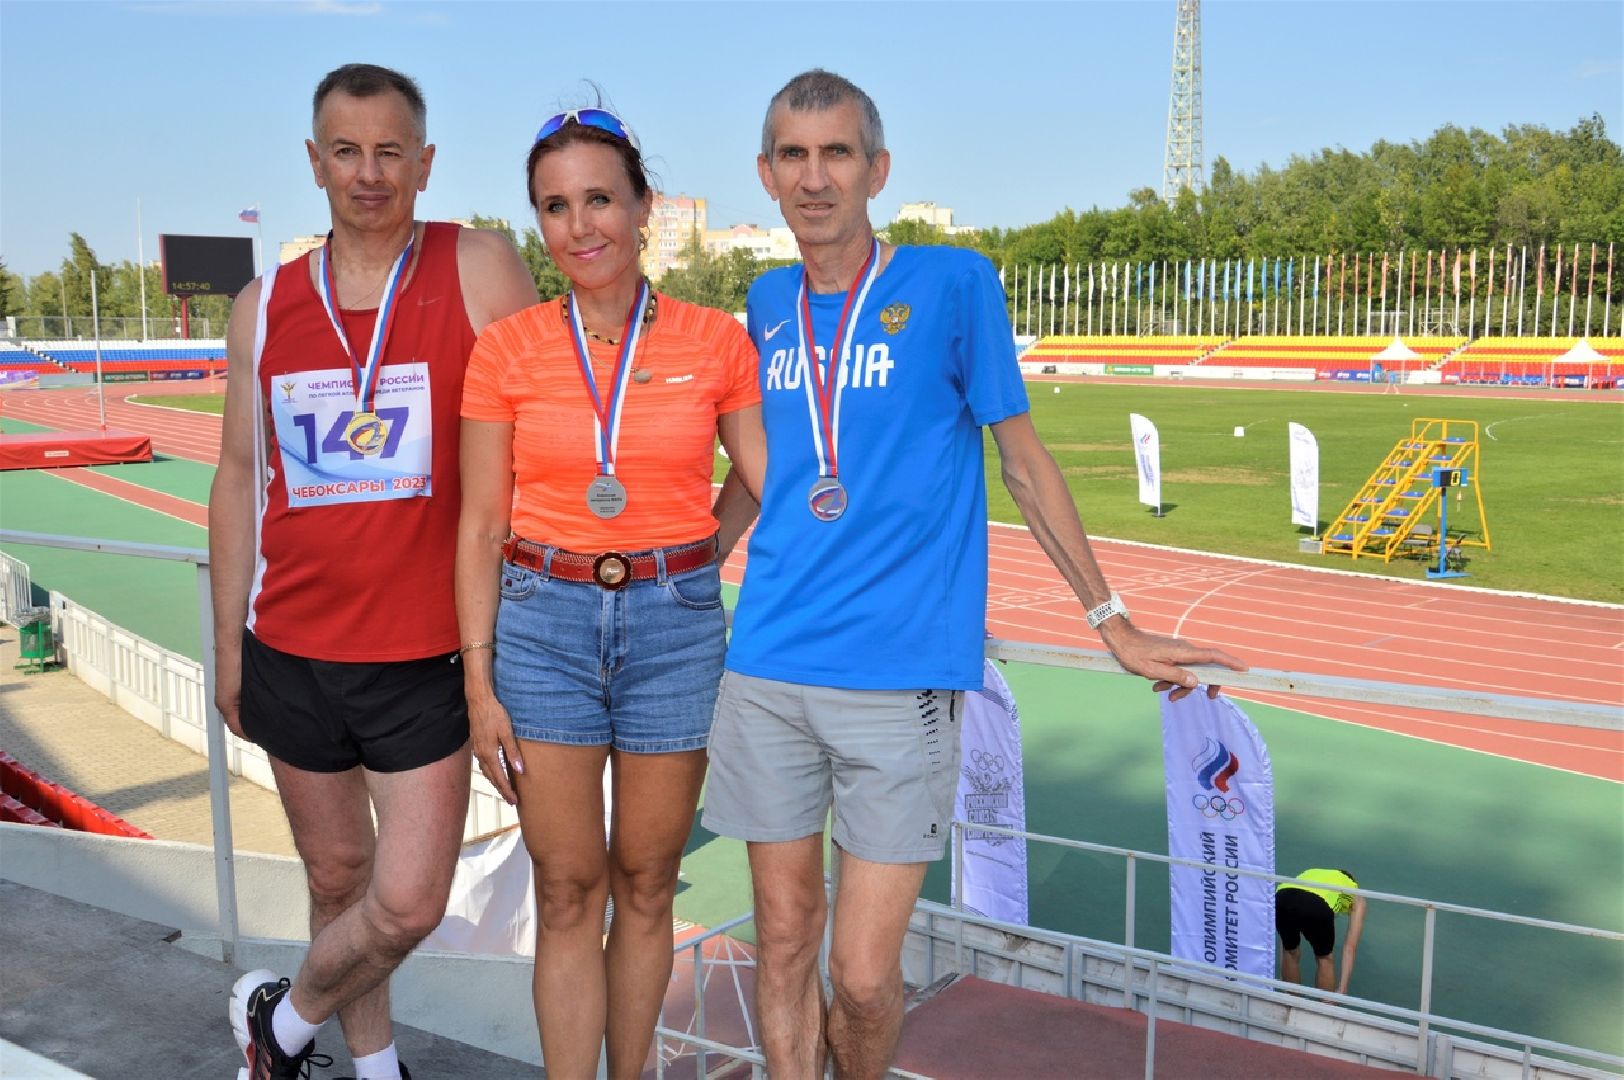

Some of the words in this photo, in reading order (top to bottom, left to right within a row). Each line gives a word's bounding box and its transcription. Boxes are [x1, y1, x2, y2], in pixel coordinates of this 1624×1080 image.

[307, 379, 354, 390] ЧЕМПИО
[379, 374, 424, 386] РОССИИ
[292, 406, 410, 465] 147
[292, 480, 385, 498] ЧЕБОКСАРЫ
[1200, 831, 1217, 964] ОЛИМПИЙСКИЙ
[1224, 906, 1239, 981] МИТЕТ
